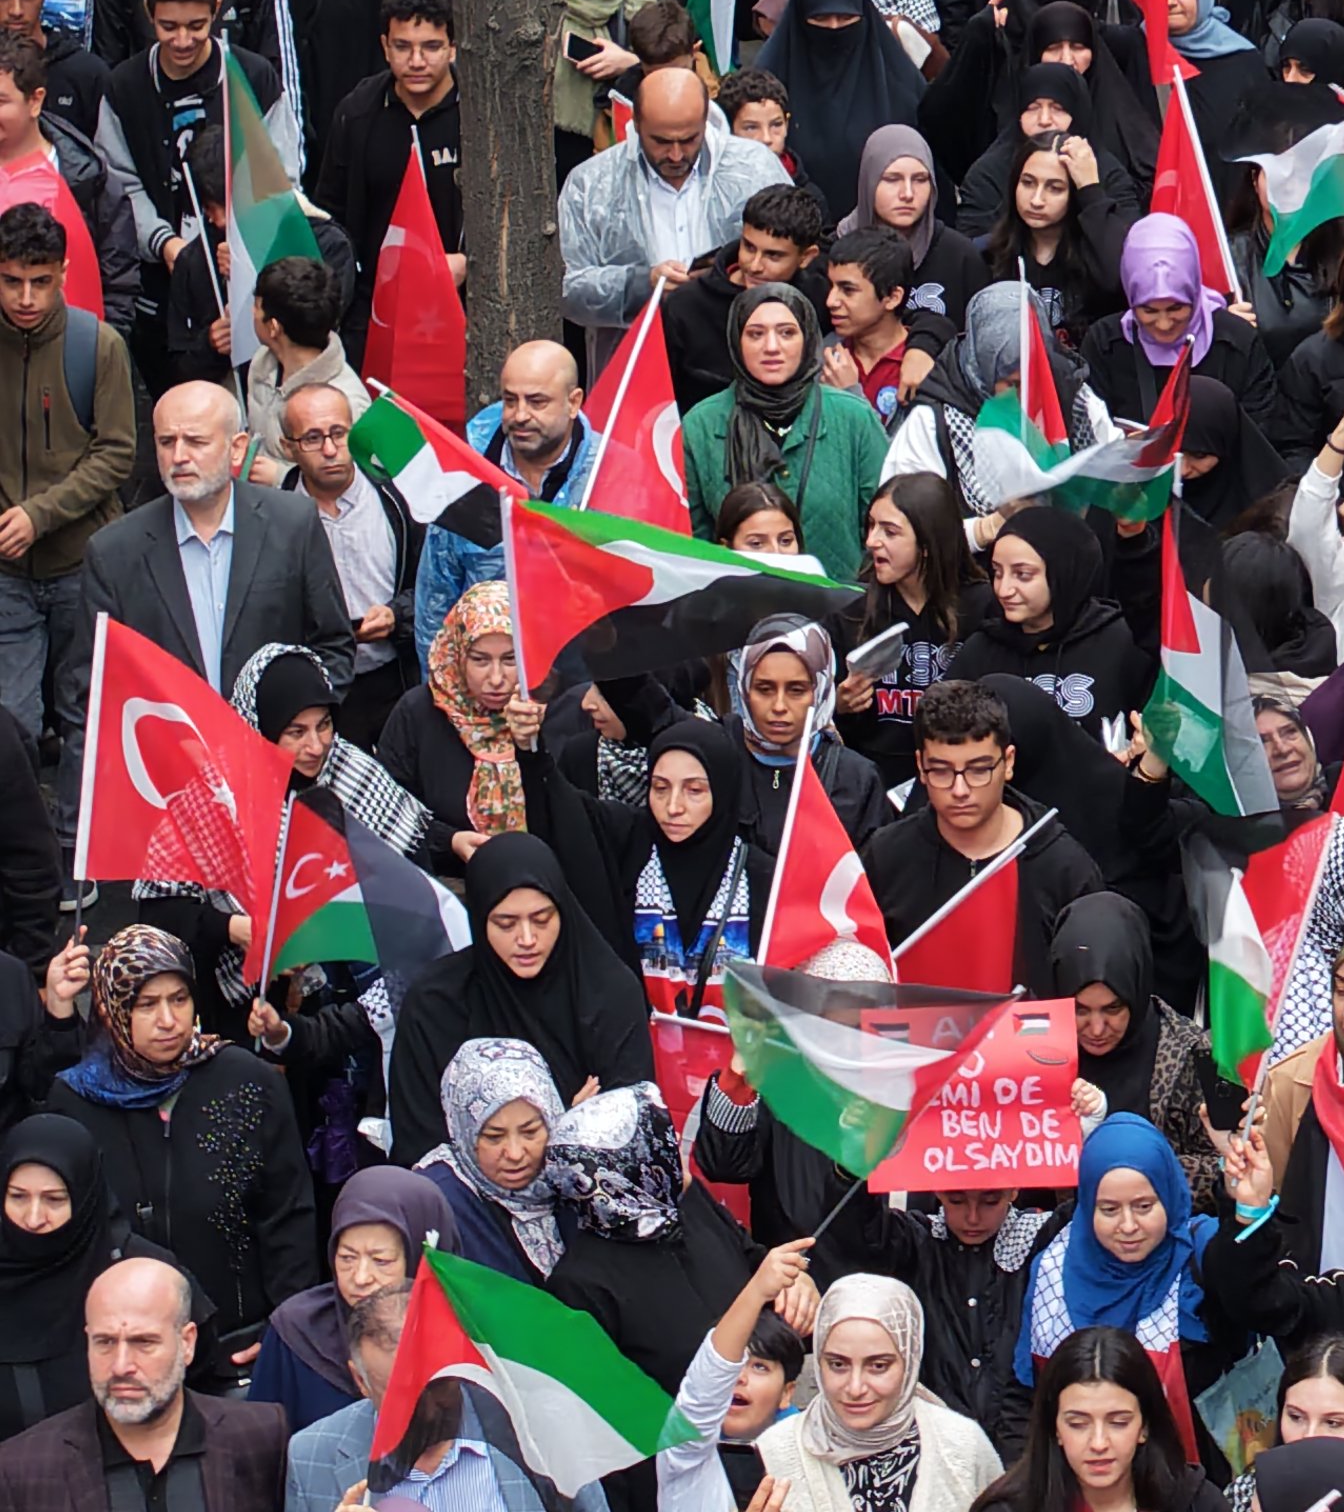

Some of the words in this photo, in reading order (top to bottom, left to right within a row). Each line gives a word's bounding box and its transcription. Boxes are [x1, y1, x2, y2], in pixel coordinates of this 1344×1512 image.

[993, 1075, 1044, 1105] DE
[941, 1109, 1002, 1141] BEN
[1019, 1108, 1061, 1139] DE
[923, 1139, 1079, 1173] OLSAYDIM
